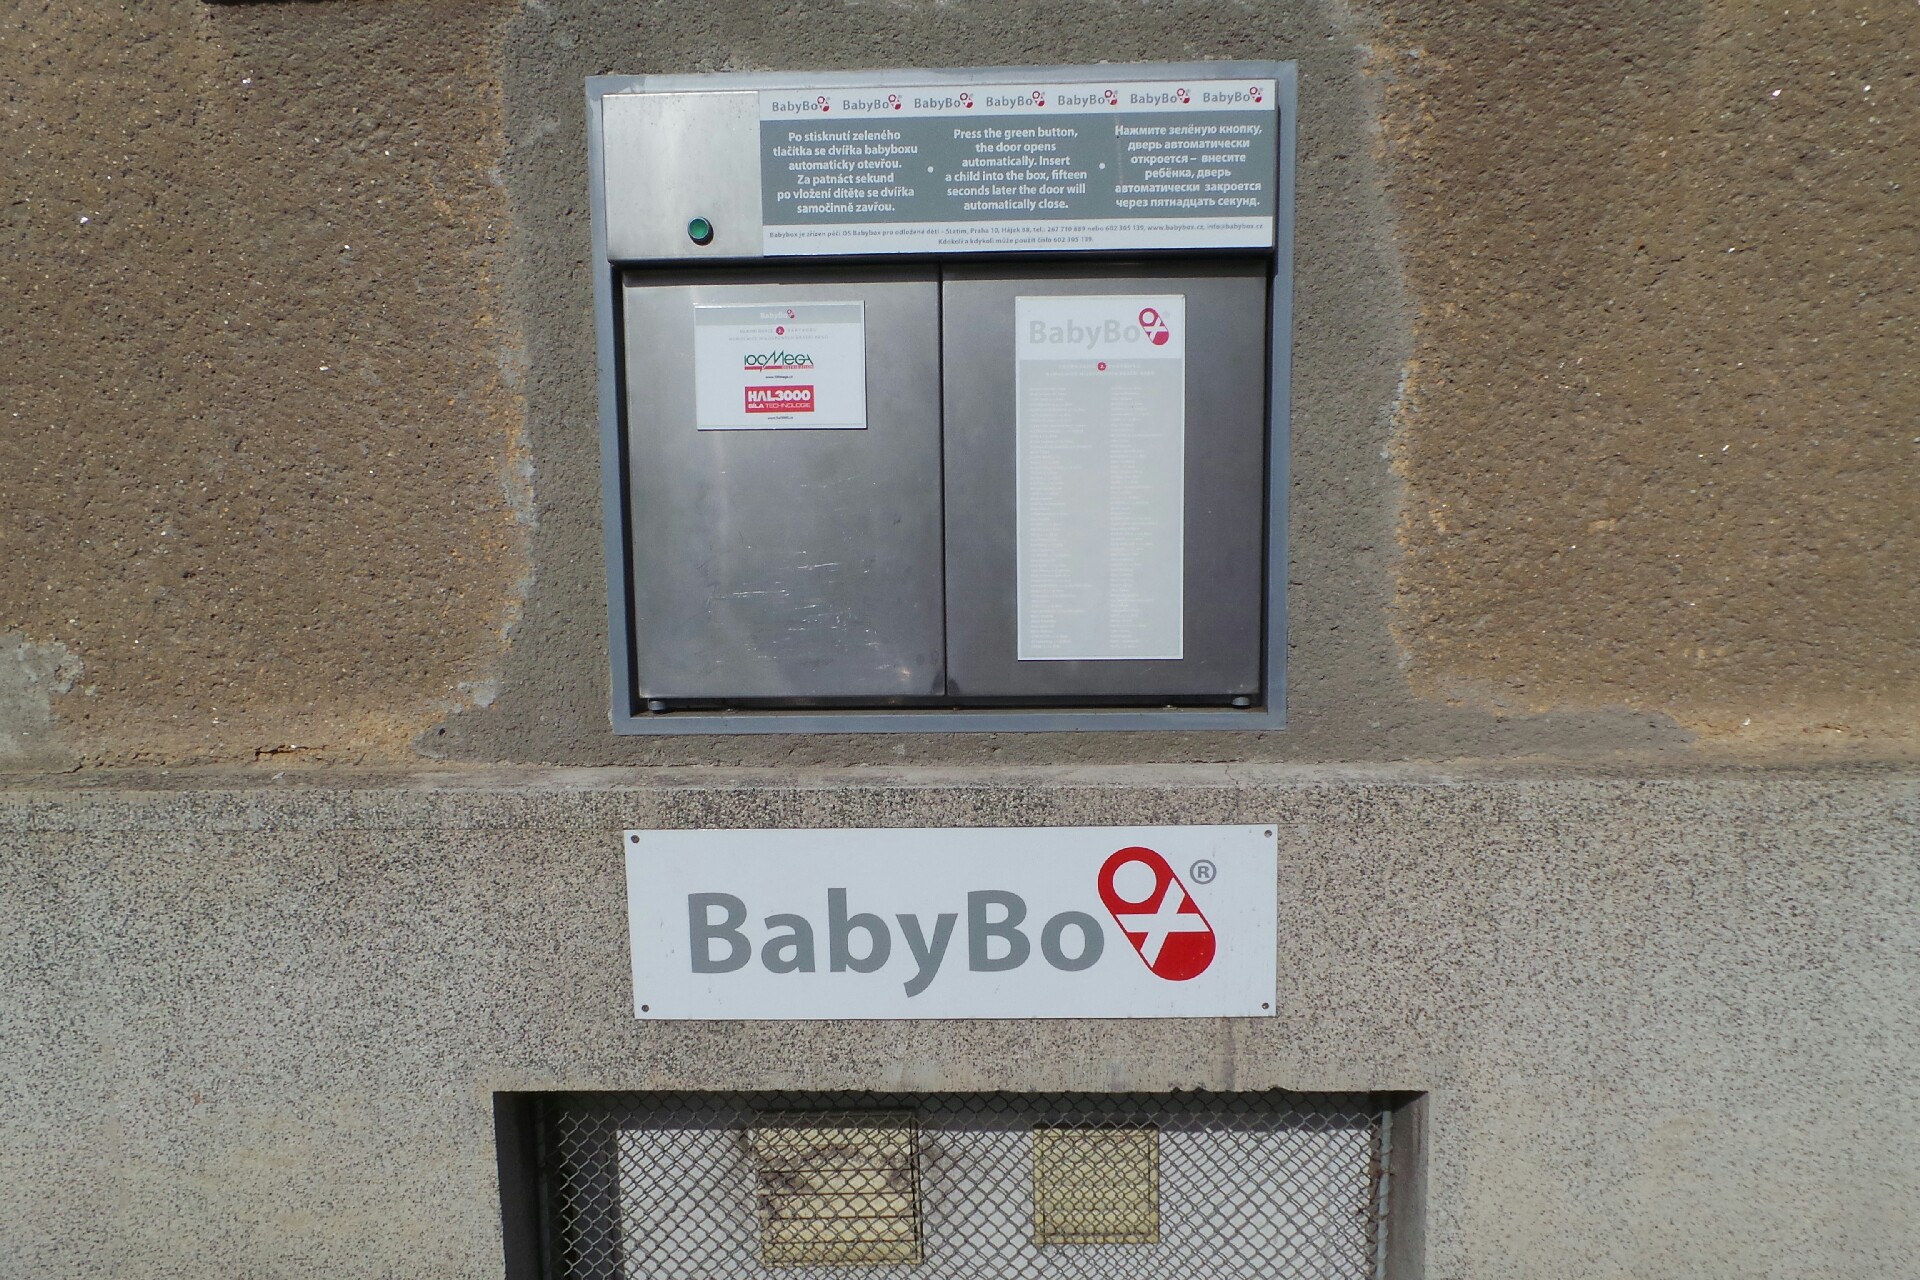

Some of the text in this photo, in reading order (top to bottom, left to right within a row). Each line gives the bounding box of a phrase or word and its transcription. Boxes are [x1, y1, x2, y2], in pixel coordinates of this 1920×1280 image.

[789, 130, 900, 141] Po stisknutí zeleného
[954, 127, 1078, 140] Press the green button,
[1115, 124, 1262, 136] Нажмите зелёную кнопку,
[773, 146, 812, 156] tlačítka
[828, 145, 862, 155] dvířka
[865, 144, 918, 156] babyboxu
[976, 142, 1056, 153] the door opens
[1128, 139, 1250, 151] дверь автоматически
[789, 159, 902, 171] automaticky otevřou.
[962, 156, 1070, 168] automatically. Insert
[1131, 154, 1188, 165] откроется
[1202, 154, 1246, 163] внесите
[798, 173, 894, 186] Za patnáct sekund
[954, 172, 980, 181] child
[983, 171, 1003, 181] into
[1006, 171, 1024, 180] the
[1026, 170, 1049, 181] box,
[1052, 169, 1087, 179] fifteen
[1145, 167, 1231, 180] ребёнка, дверь
[947, 184, 1085, 196] seconds later the door will
[1115, 182, 1261, 193] автоматически закроется
[778, 187, 914, 201] po vložení dítěte se dvířka
[797, 202, 895, 213] samočinně zavřou.
[964, 199, 1068, 211] automatically close.
[1116, 197, 1260, 209] через пятнадцать секунд.
